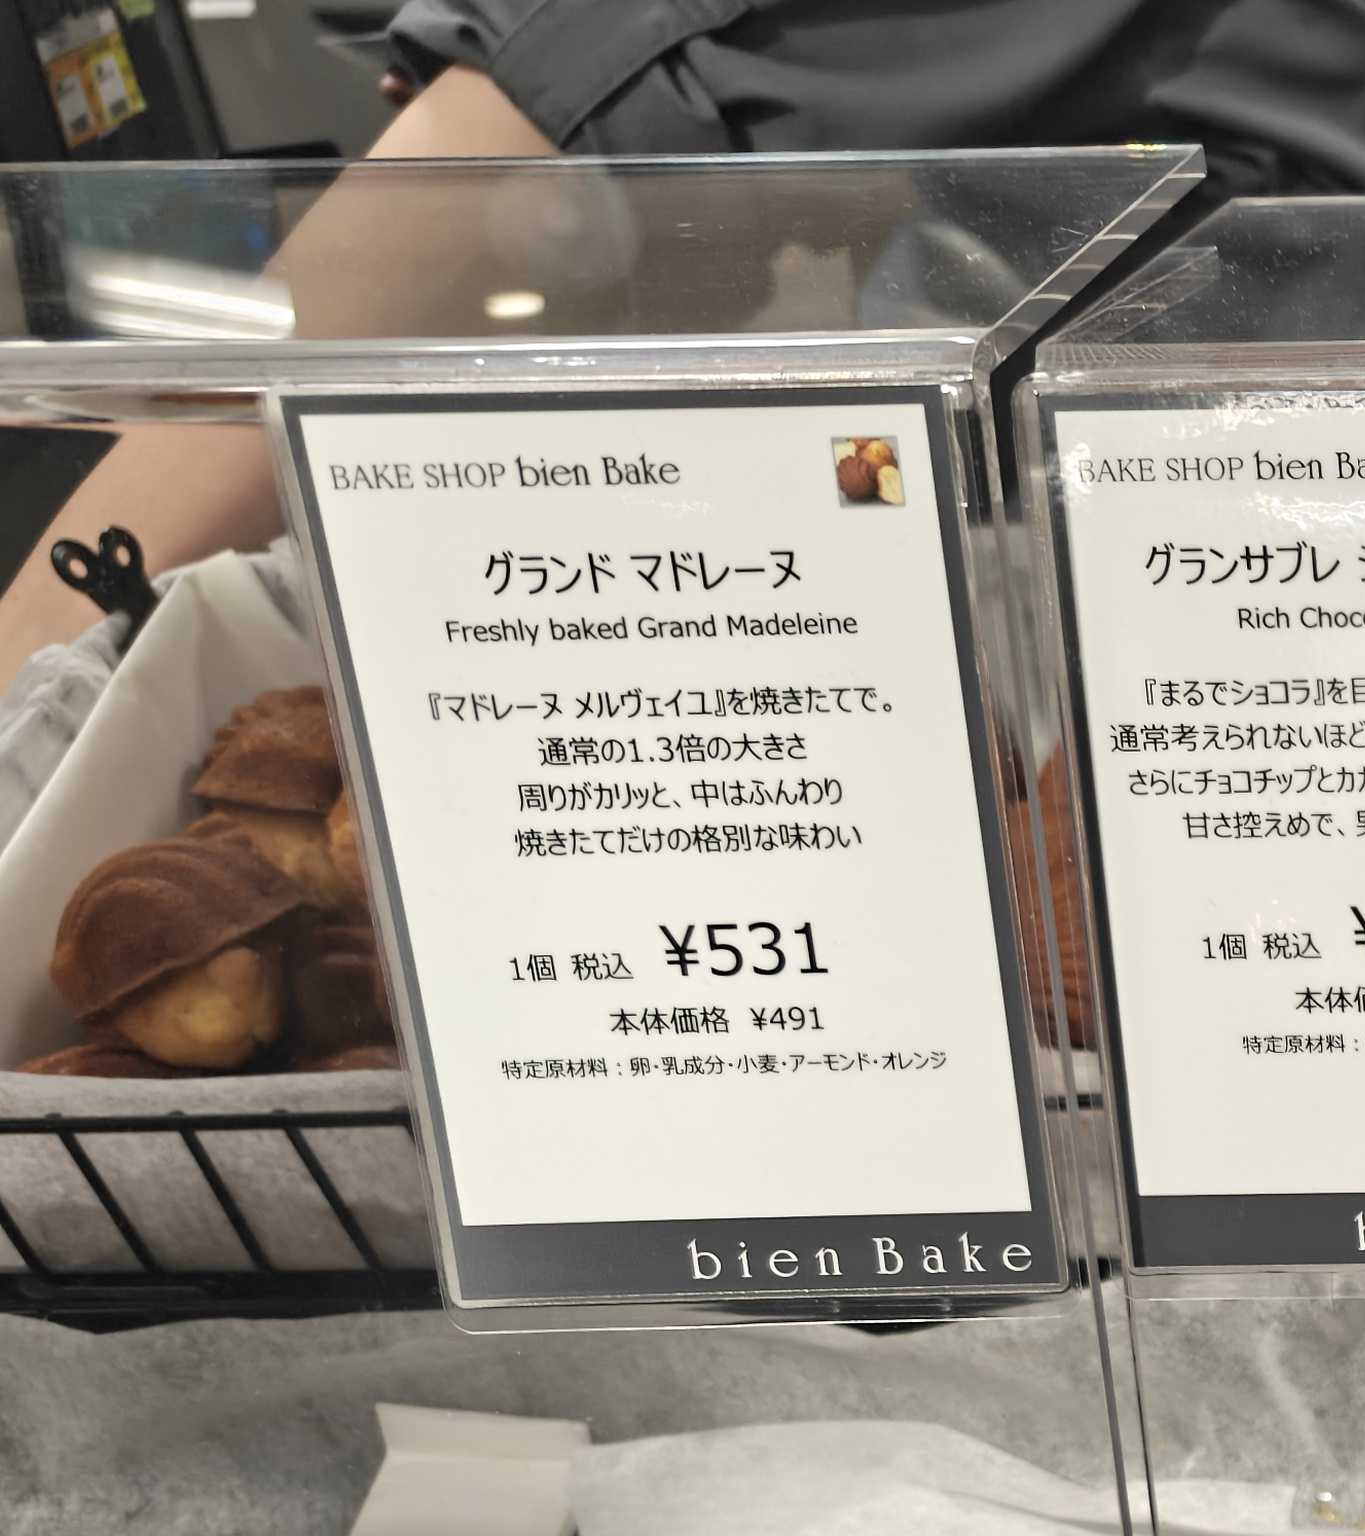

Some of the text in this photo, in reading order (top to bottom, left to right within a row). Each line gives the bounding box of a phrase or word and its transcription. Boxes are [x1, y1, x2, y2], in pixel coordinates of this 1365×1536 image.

[329, 453, 680, 490] BAKE SHOP bien Bake
[1080, 458, 1156, 483] BAKE
[1166, 456, 1244, 482] SHOP
[1253, 450, 1324, 481] bien
[484, 550, 801, 596] グランド マドレーヌ
[1145, 540, 1341, 586] グランサブレ
[445, 612, 858, 647] Freshly baked Grand Madeleine
[1237, 606, 1290, 630] Rich
[428, 692, 563, 722] 『マドレーヌ
[537, 732, 808, 767] 通常の1.3倍の大きさ
[514, 822, 862, 857] 焼きたてだけの格別な味わい
[509, 921, 829, 982] 1個 税込 ¥531
[1202, 933, 1248, 961] 1個
[1262, 932, 1322, 960] 税込
[609, 1005, 825, 1036] 本体価格 ¥491
[687, 1231, 1032, 1280] bien Bake
